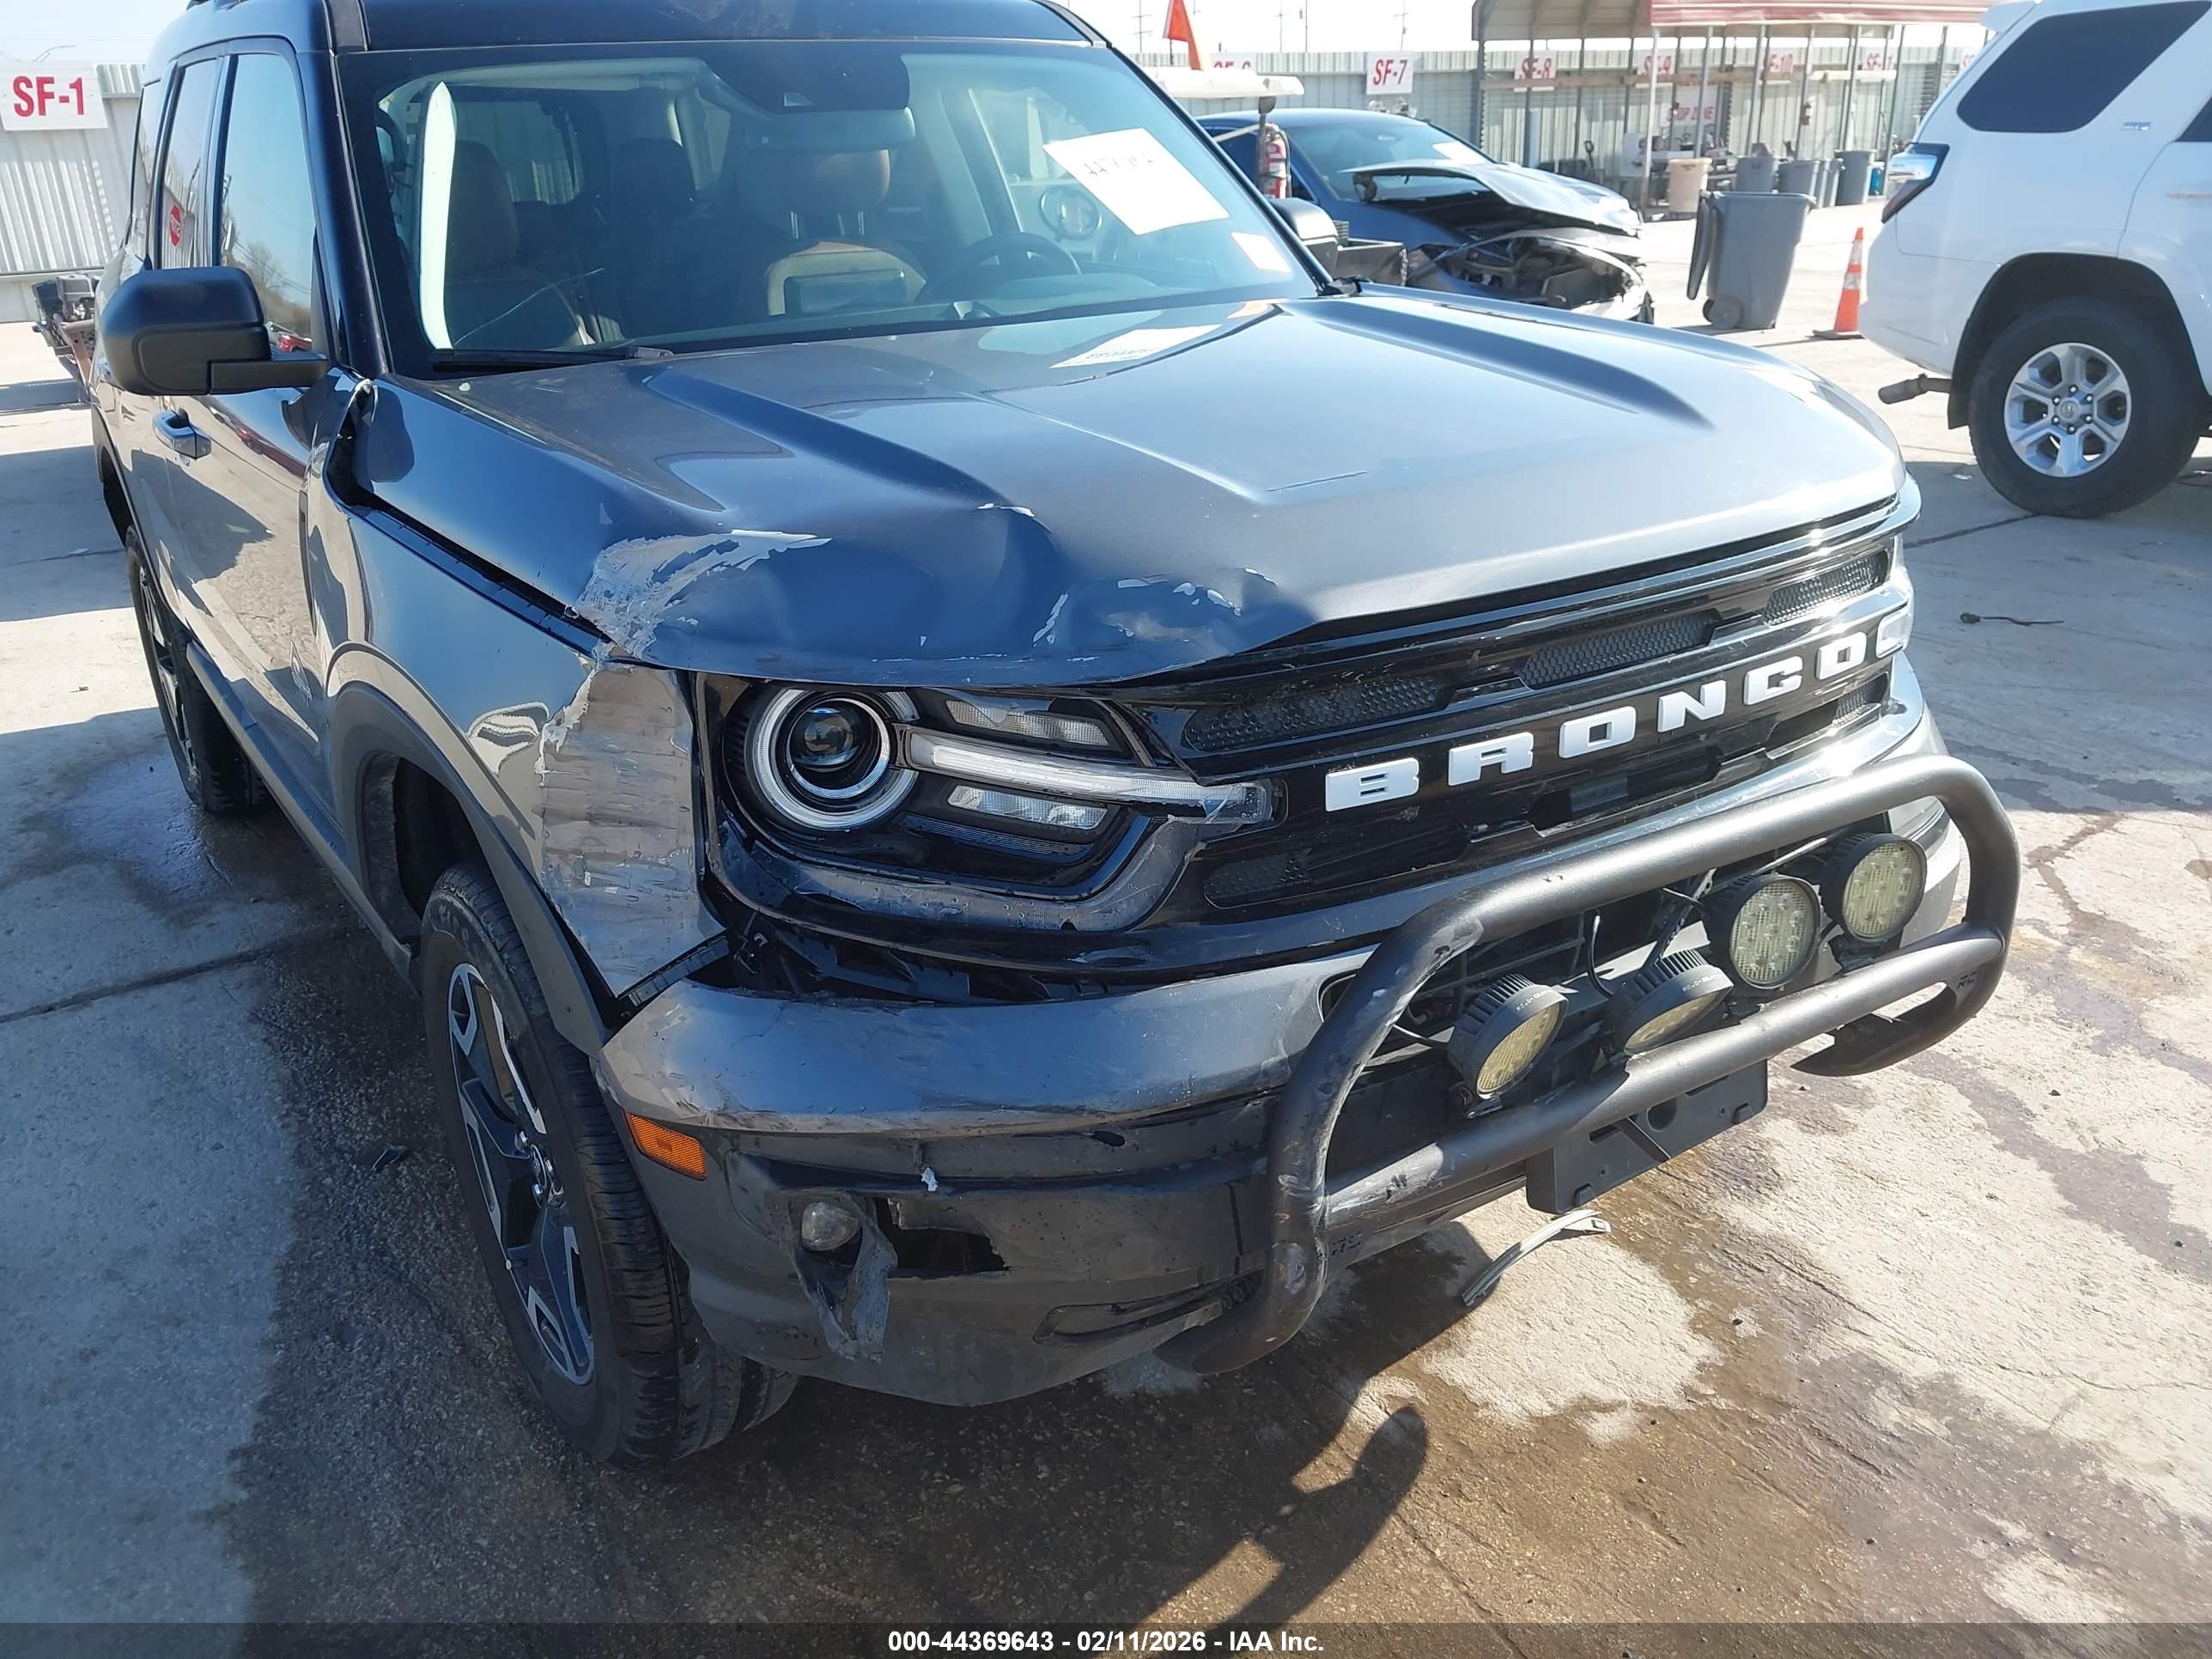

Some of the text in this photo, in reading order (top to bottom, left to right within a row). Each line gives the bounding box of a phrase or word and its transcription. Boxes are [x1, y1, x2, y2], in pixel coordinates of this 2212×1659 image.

[1373, 58, 1407, 85] SF-7
[12, 76, 84, 117] SF-1
[1325, 631, 1868, 811] BRONCO
